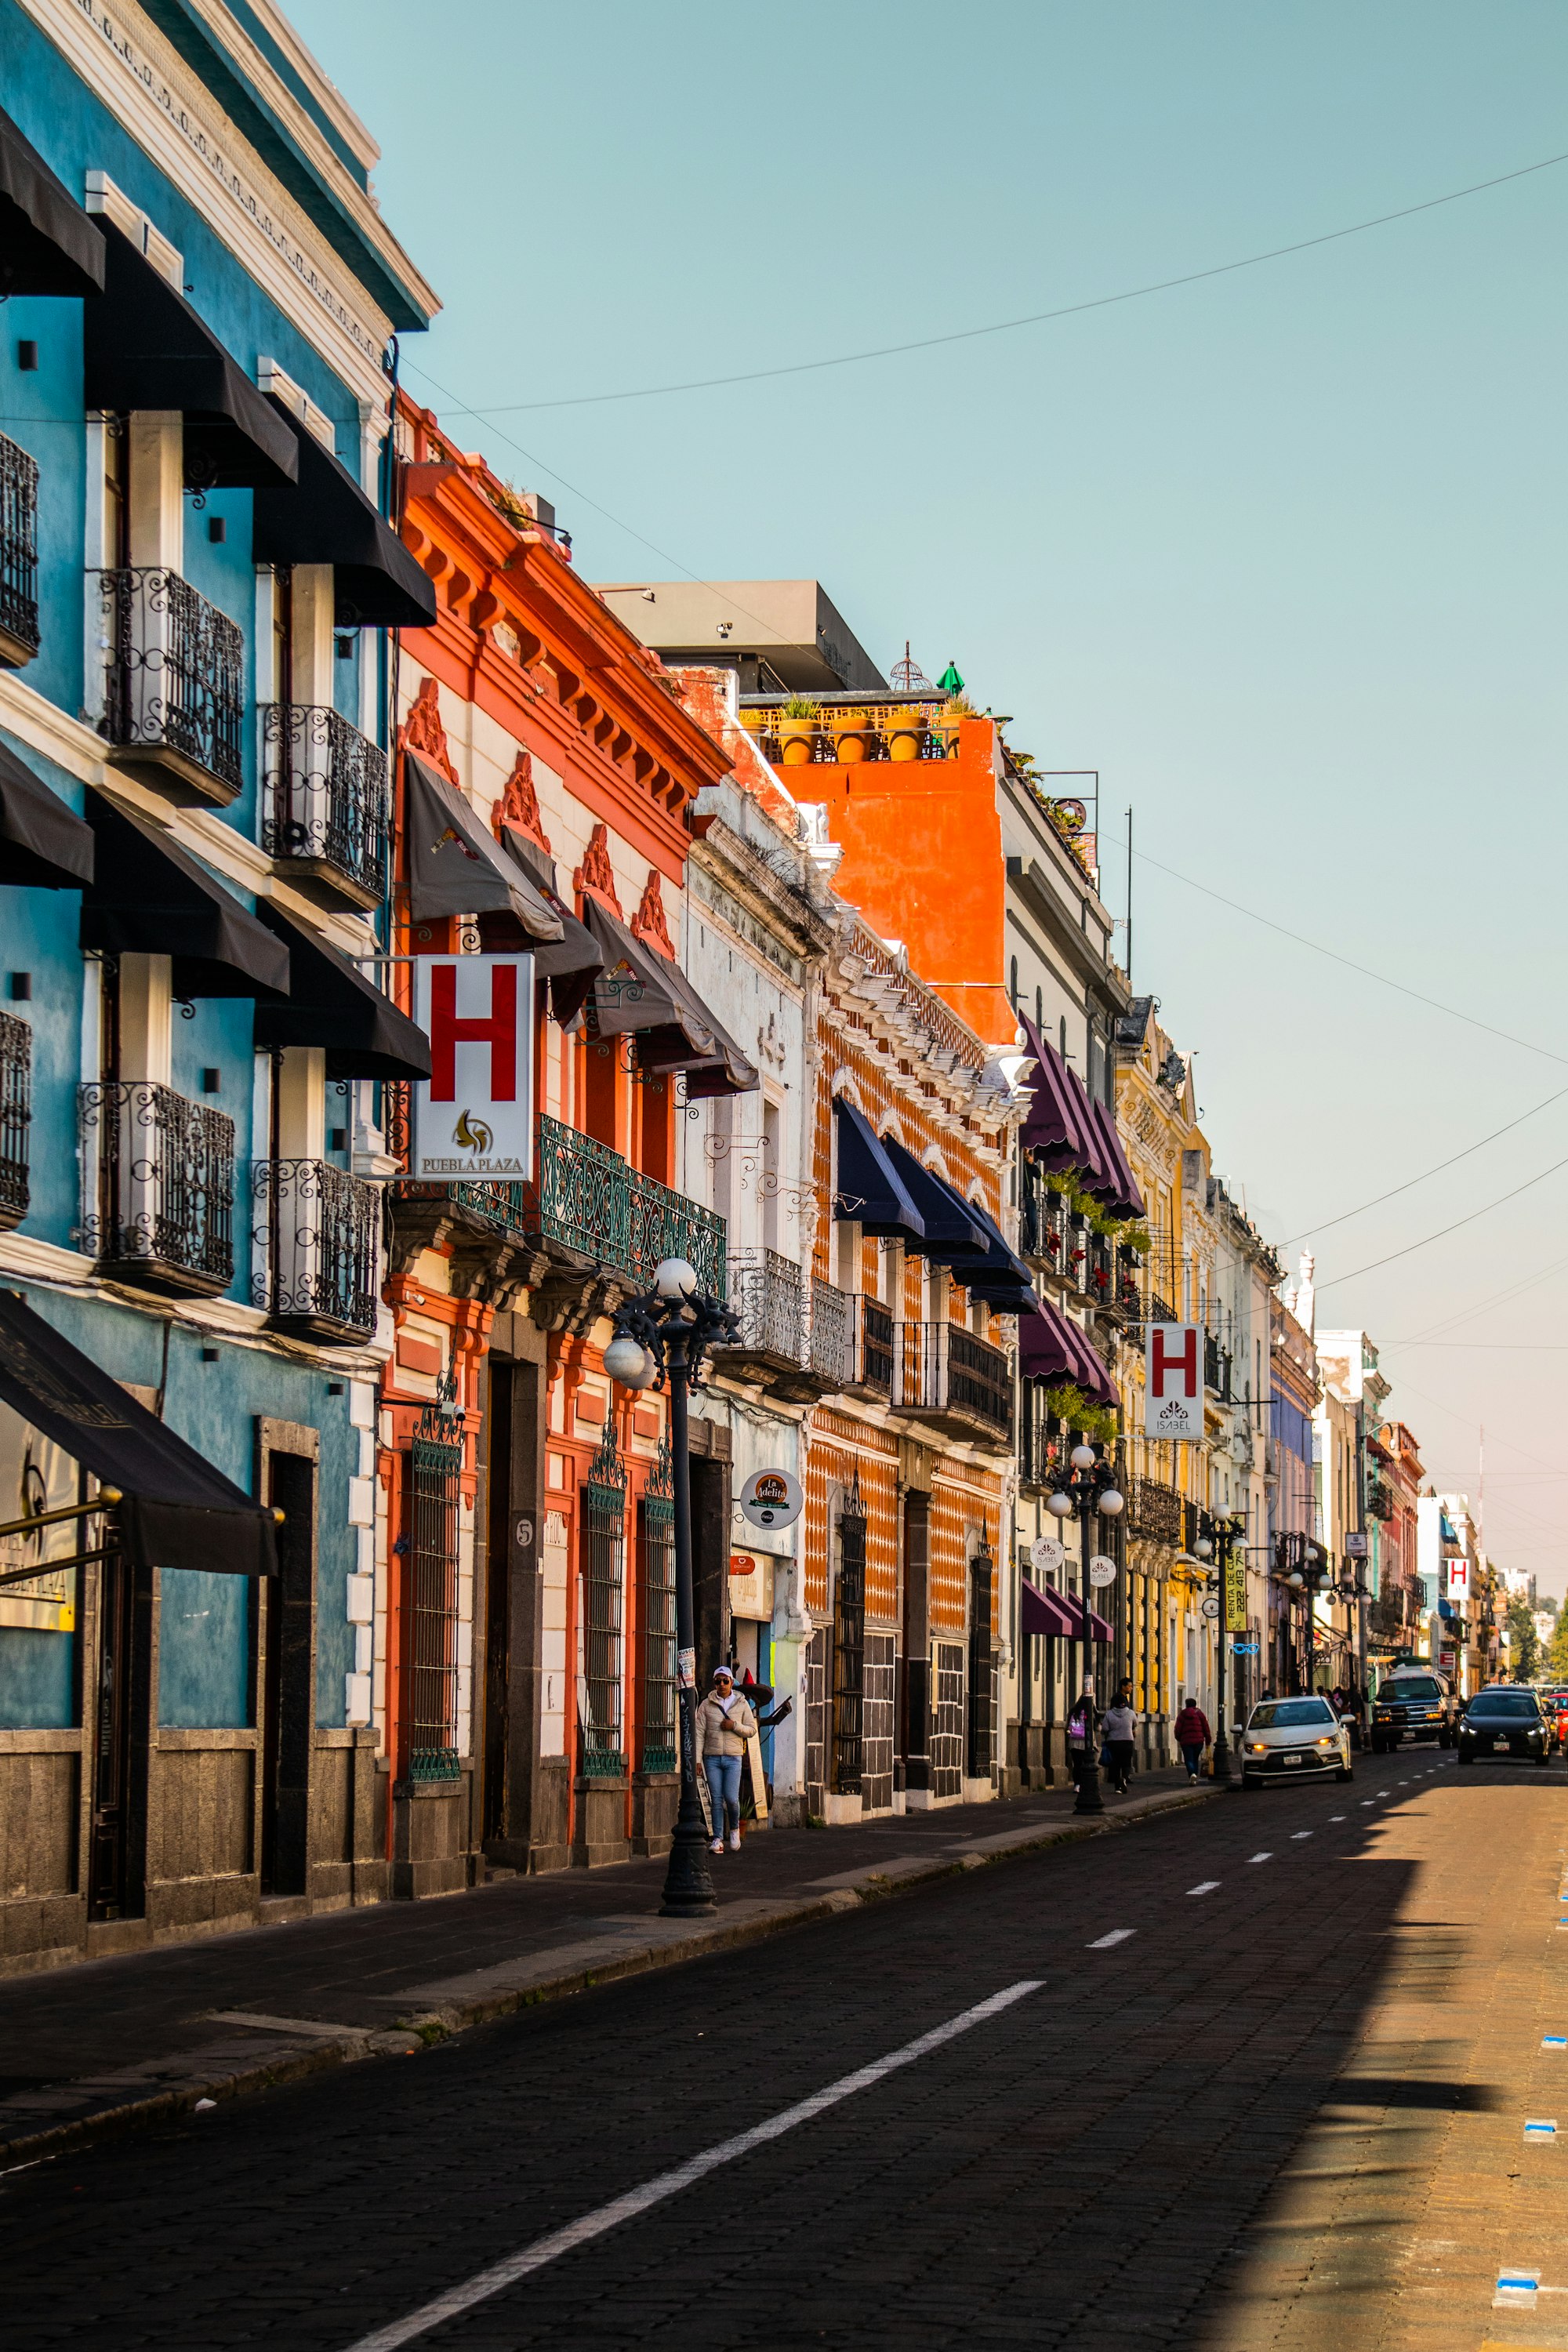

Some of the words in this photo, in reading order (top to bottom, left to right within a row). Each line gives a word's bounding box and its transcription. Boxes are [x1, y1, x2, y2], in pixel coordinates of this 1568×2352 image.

[430, 964, 517, 1102] H
[422, 1157, 475, 1171] PUEBLA
[477, 1157, 522, 1171] PLAZA
[1152, 1328, 1196, 1398] H
[1156, 1421, 1191, 1430] ISABEL
[768, 1479, 777, 1488] La
[757, 1487, 786, 1498] Adelita
[518, 1523, 530, 1544] 5
[1227, 1573, 1234, 1585] DE
[1236, 1570, 1244, 1587] 413
[1450, 1560, 1466, 1584] H
[1236, 1591, 1245, 1613] 222
[1439, 1653, 1454, 1664] E
